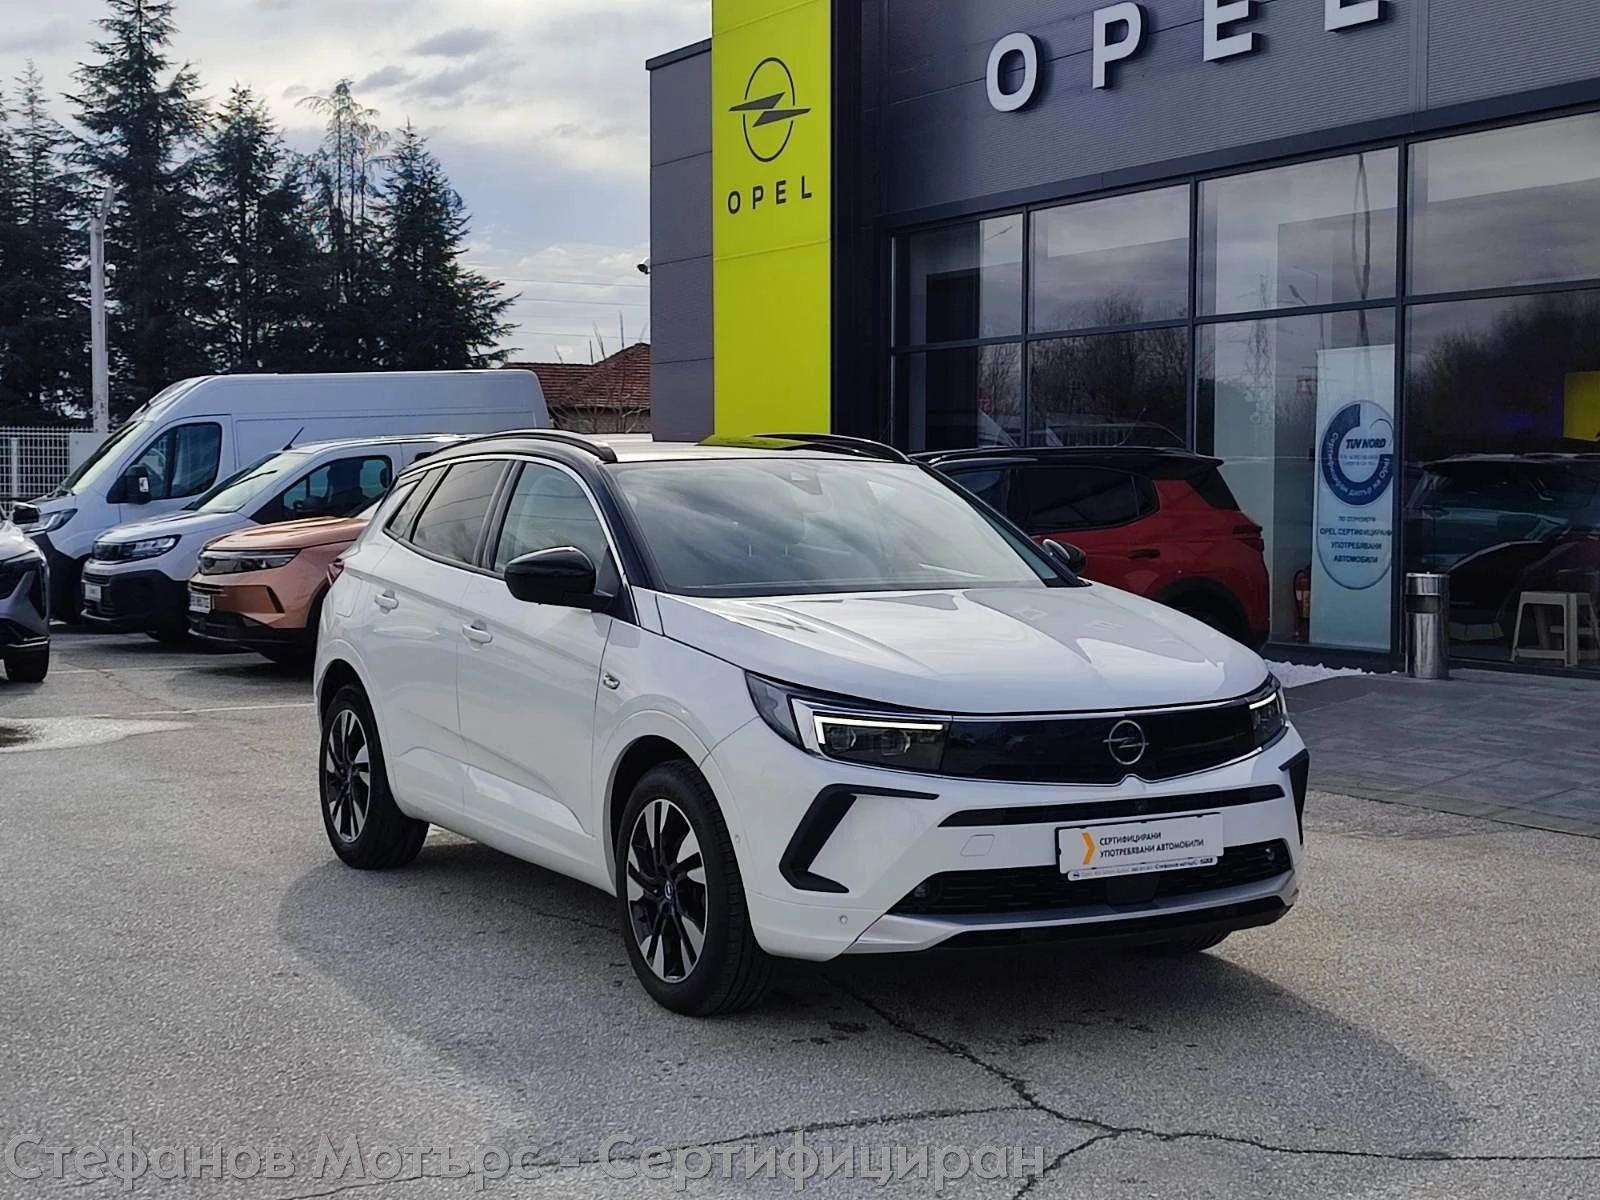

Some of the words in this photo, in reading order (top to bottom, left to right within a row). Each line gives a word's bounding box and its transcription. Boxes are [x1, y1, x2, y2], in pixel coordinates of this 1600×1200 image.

[728, 176, 812, 214] OPEL
[1362, 438, 1386, 449] NORD
[1333, 555, 1378, 563] АВТОМОБИЛИ
[1100, 832, 1161, 845] СЕРТИФИЦИРАНИ
[1100, 845, 1156, 858] УПОТРЕБЯВАНИ
[1156, 839, 1204, 852] АВТОМОБИЛИ
